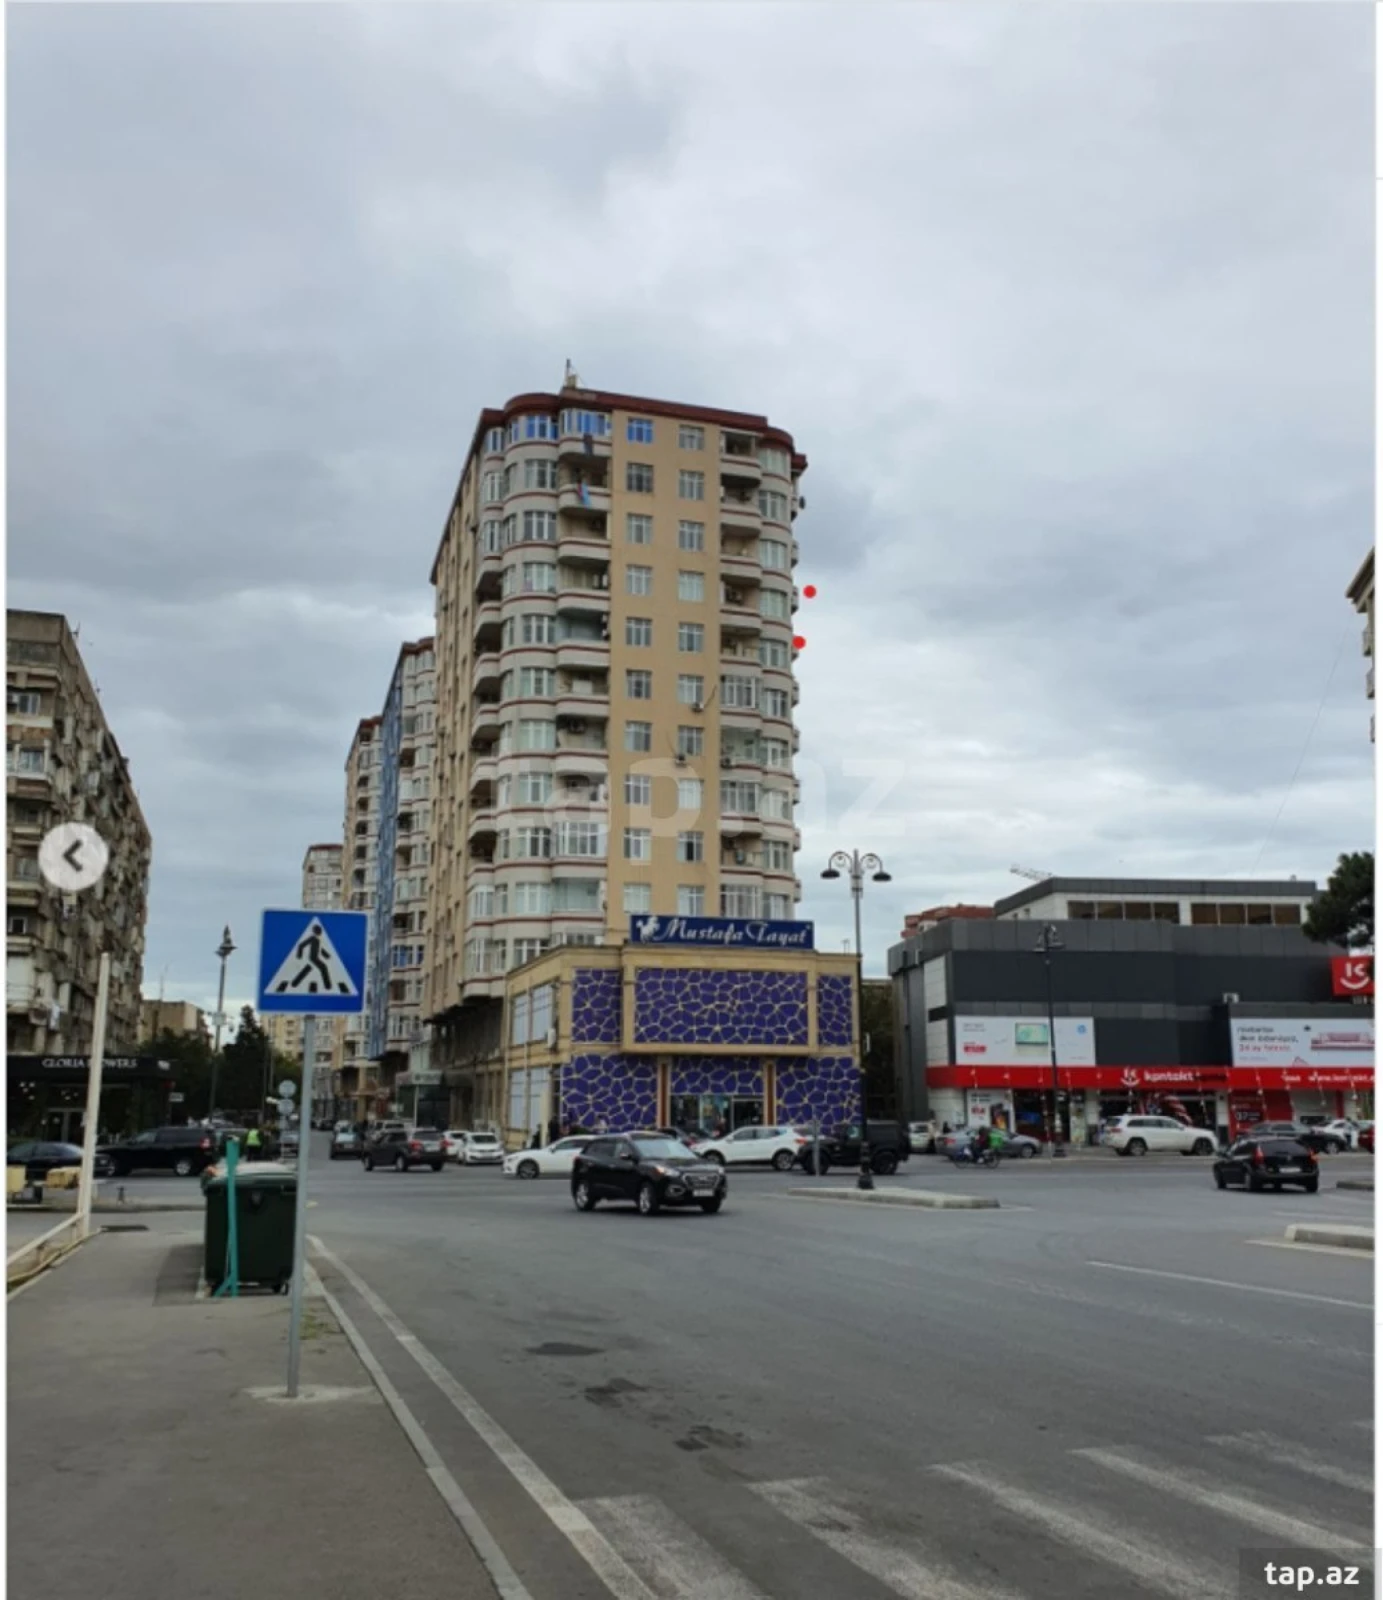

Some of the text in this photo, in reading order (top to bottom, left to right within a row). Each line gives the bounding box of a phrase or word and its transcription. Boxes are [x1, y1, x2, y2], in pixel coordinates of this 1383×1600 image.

[653, 917, 743, 944] Mustafa
[41, 1058, 86, 1068] GLORIA
[1143, 1070, 1195, 1081] kontakt
